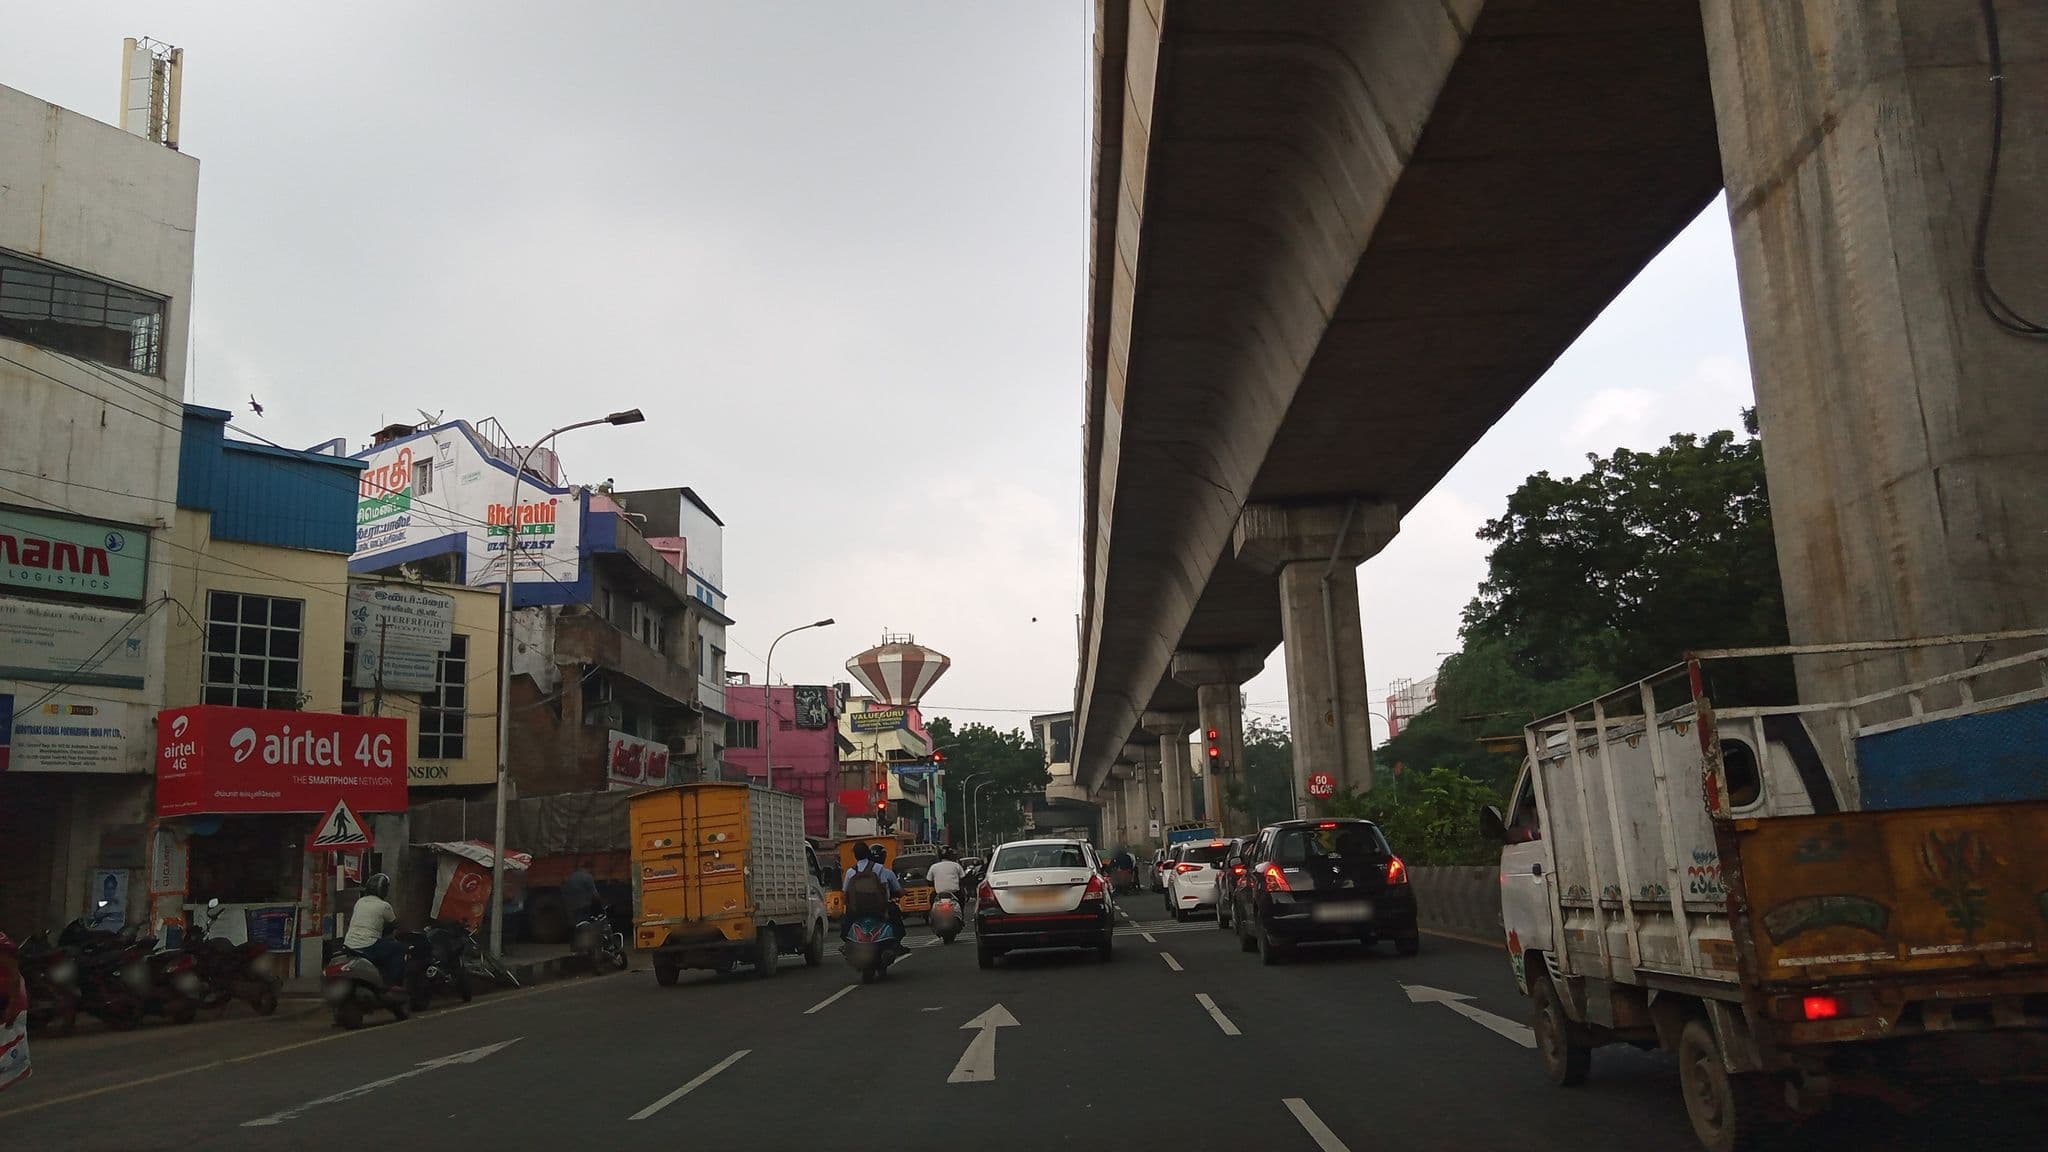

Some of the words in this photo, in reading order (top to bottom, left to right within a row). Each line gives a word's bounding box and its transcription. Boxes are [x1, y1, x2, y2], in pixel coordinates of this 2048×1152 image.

[488, 498, 557, 531] Bharathi
[487, 540, 555, 552] ULTAFAST
[9, 569, 110, 590] LOGISTICS
[852, 710, 904, 720] VALUEGURU
[164, 740, 196, 759] airtel
[262, 724, 343, 767] airtel
[354, 732, 393, 769] 4G
[172, 757, 187, 770] 4G
[292, 775, 308, 785] THE
[308, 776, 359, 786] SMARTPHONE
[359, 777, 393, 787] NETWORK
[1316, 775, 1327, 785] GO
